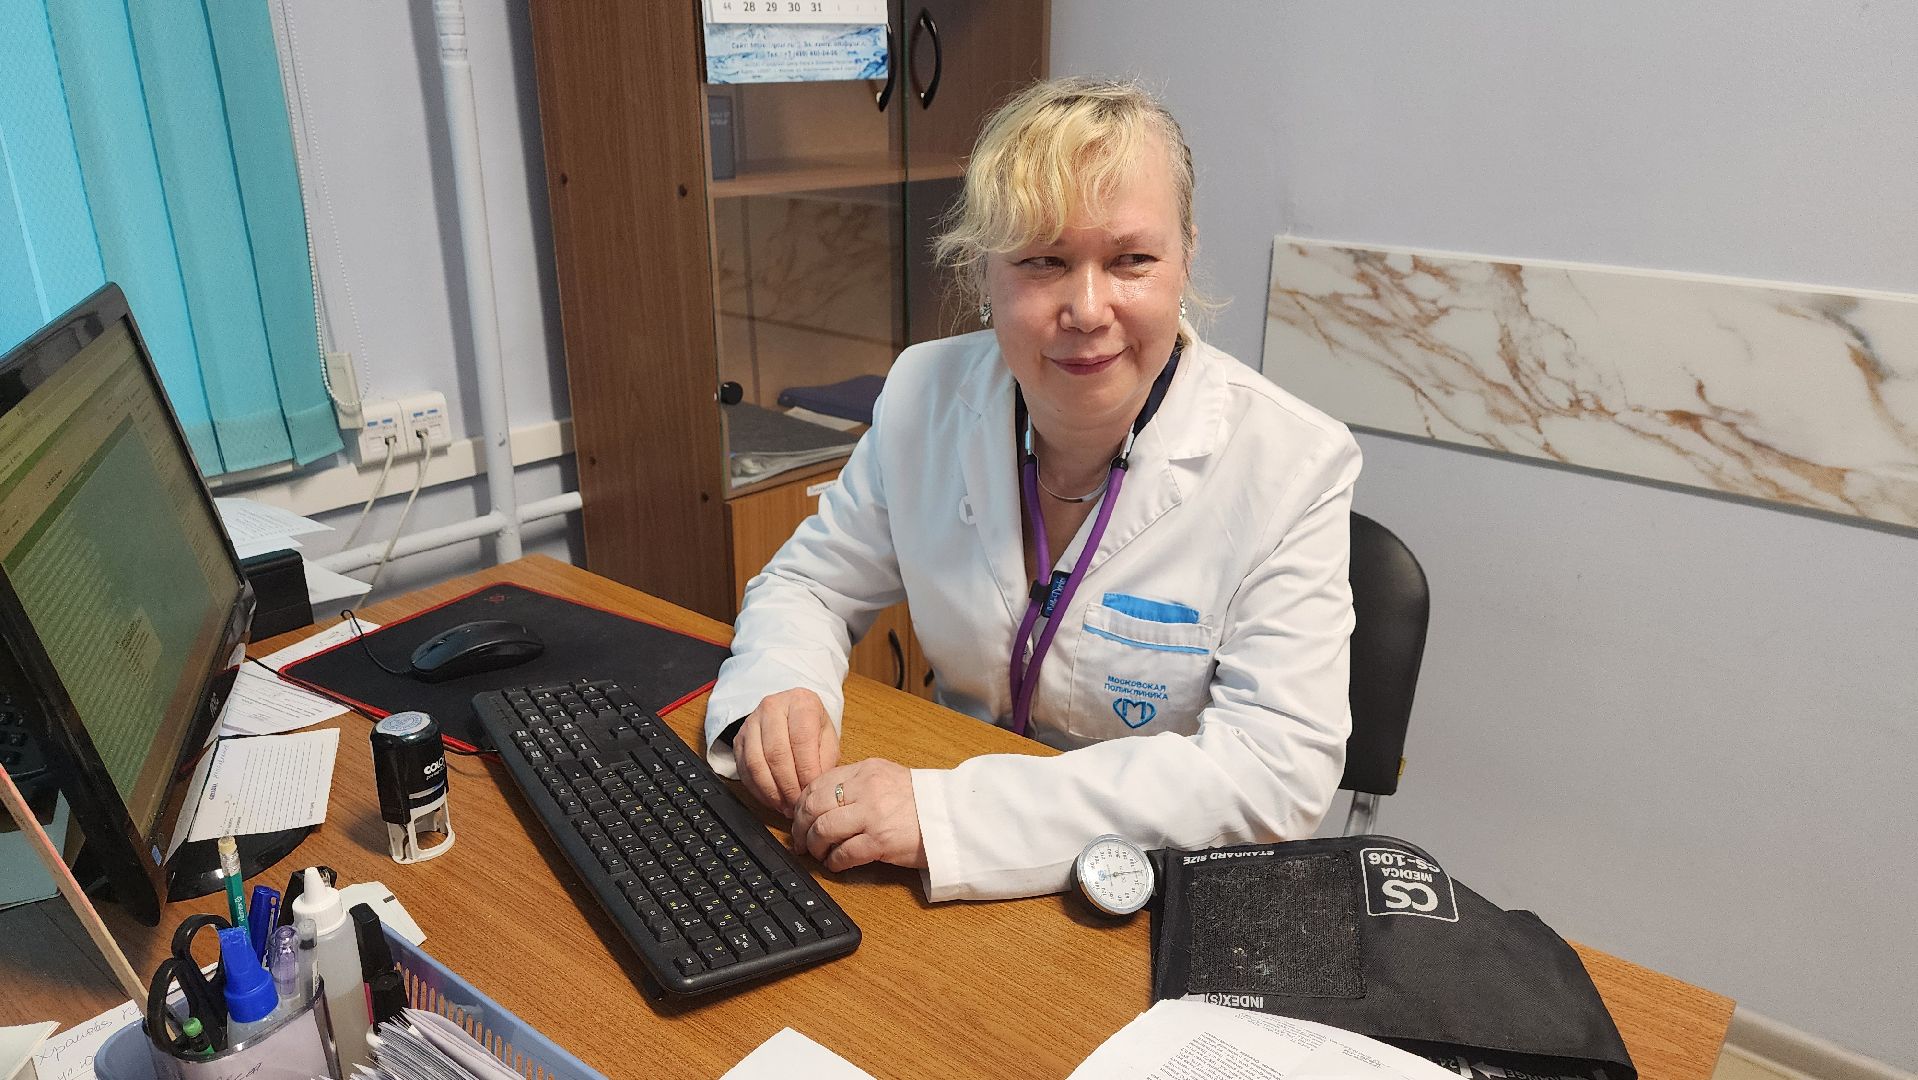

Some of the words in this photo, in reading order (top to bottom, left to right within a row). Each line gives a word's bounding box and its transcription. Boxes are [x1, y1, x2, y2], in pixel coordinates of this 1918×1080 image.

[743, 3, 756, 12] 28
[765, 3, 778, 12] 29
[787, 3, 801, 12] 30
[810, 3, 823, 12] 31
[1104, 683, 1169, 701] ПОЛИКЛИНИКА
[1107, 675, 1166, 692] МОСКОВСКАЯ
[424, 757, 446, 776] COLO
[1182, 855, 1208, 866] SIZE
[1209, 850, 1275, 860] STANDARD
[1367, 852, 1441, 873] CS-106
[1381, 867, 1433, 883] MEDICA
[1382, 879, 1438, 912] CS
[1205, 992, 1264, 1009] INDEX(S)
